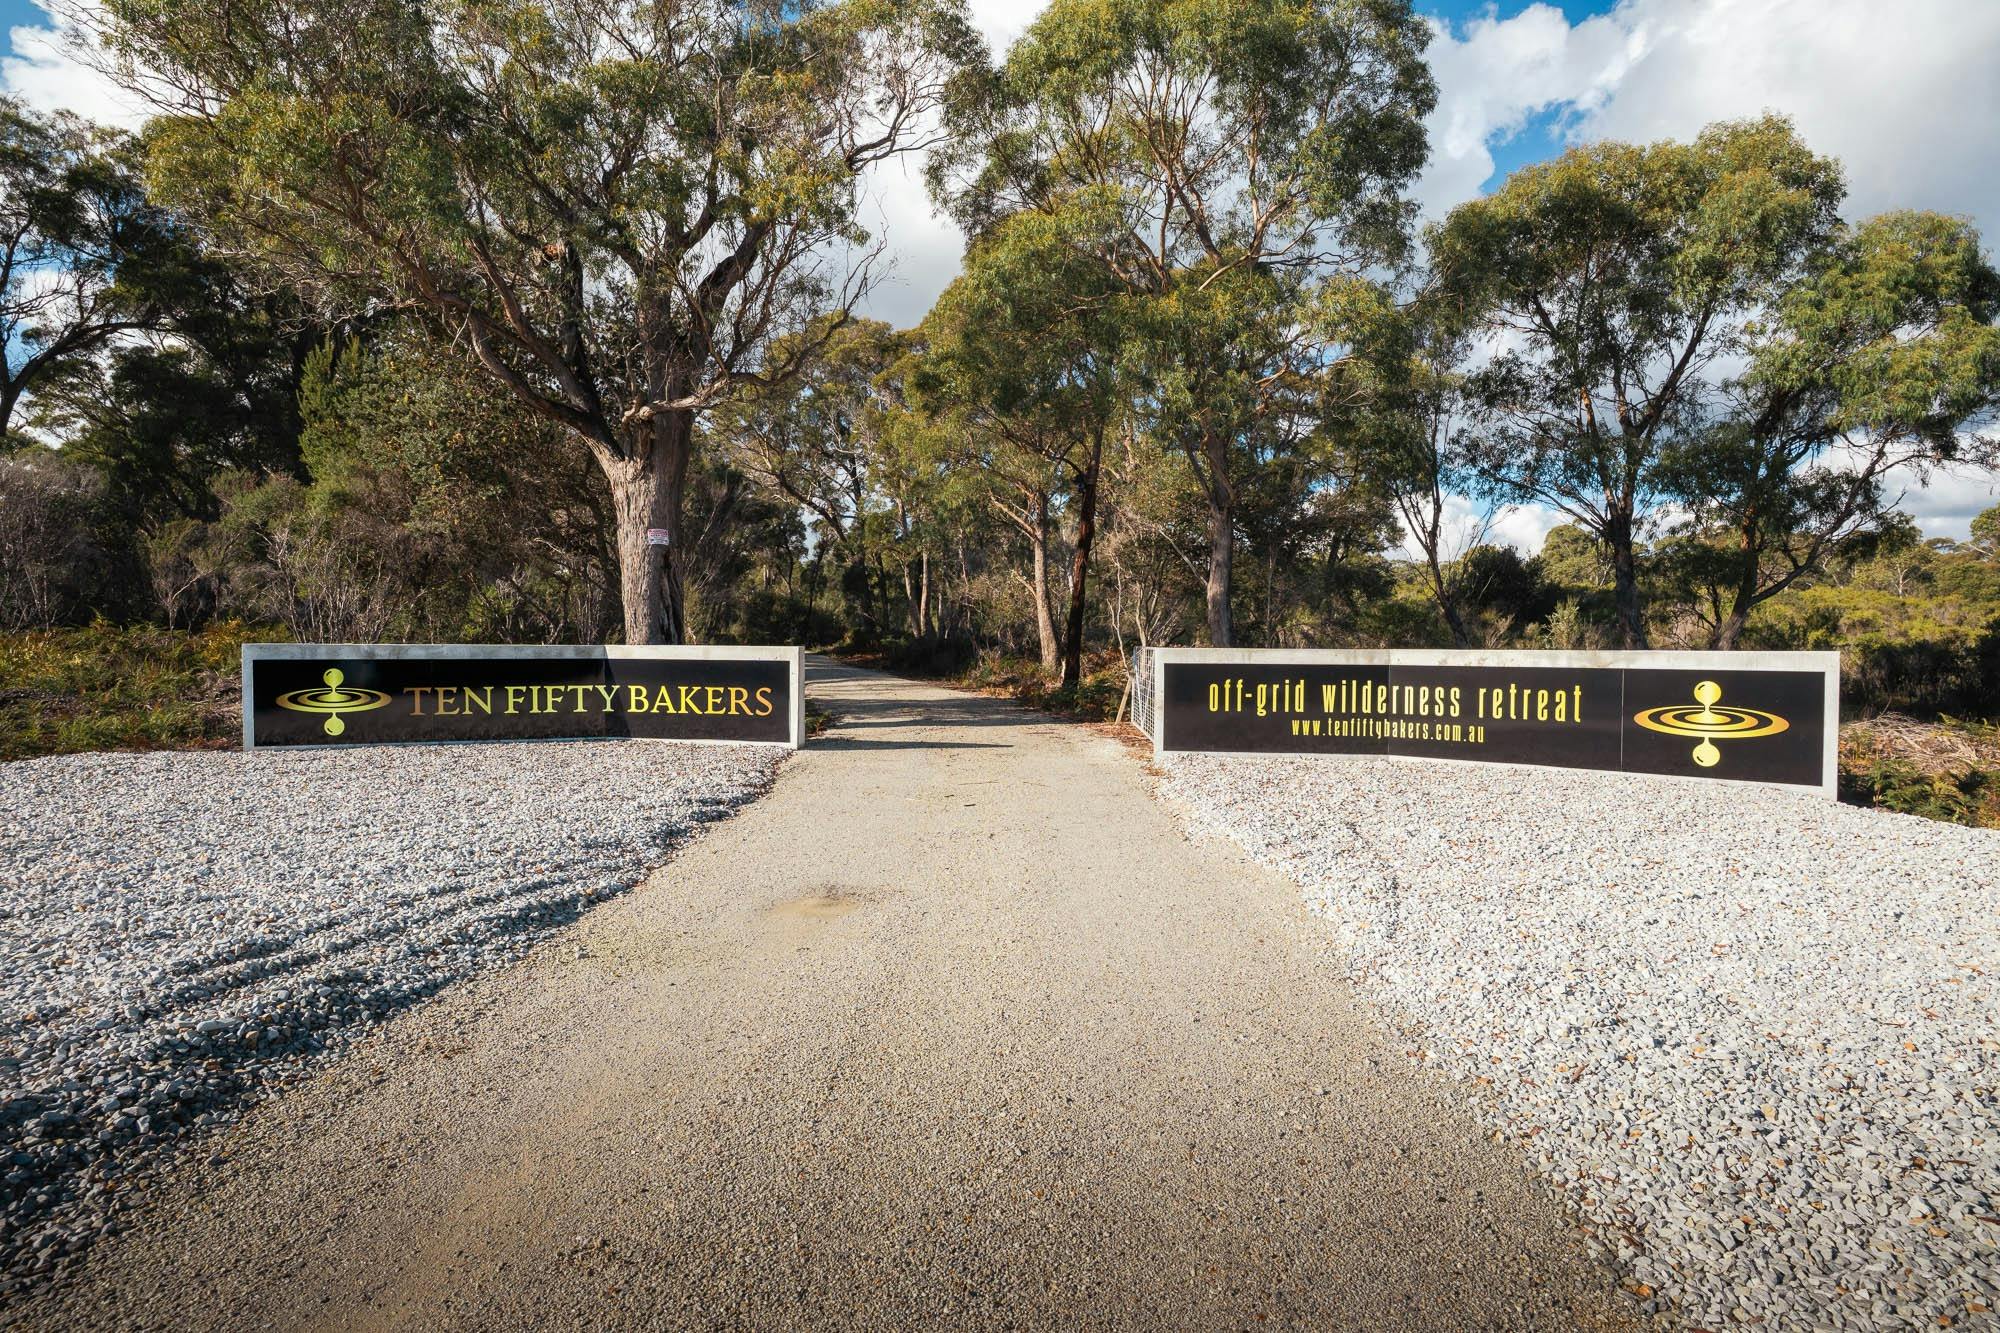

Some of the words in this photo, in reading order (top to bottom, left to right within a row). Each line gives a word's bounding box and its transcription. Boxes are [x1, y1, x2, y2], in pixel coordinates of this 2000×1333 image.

[403, 686, 494, 716] TEN
[504, 684, 621, 715] FIFTY
[627, 685, 773, 717] BAKERS
[1208, 678, 1305, 717] off-grid
[1321, 679, 1461, 718] wilderness
[1478, 683, 1582, 723] retreat
[1291, 717, 1485, 744] www.tenfiftybakers.com.au
